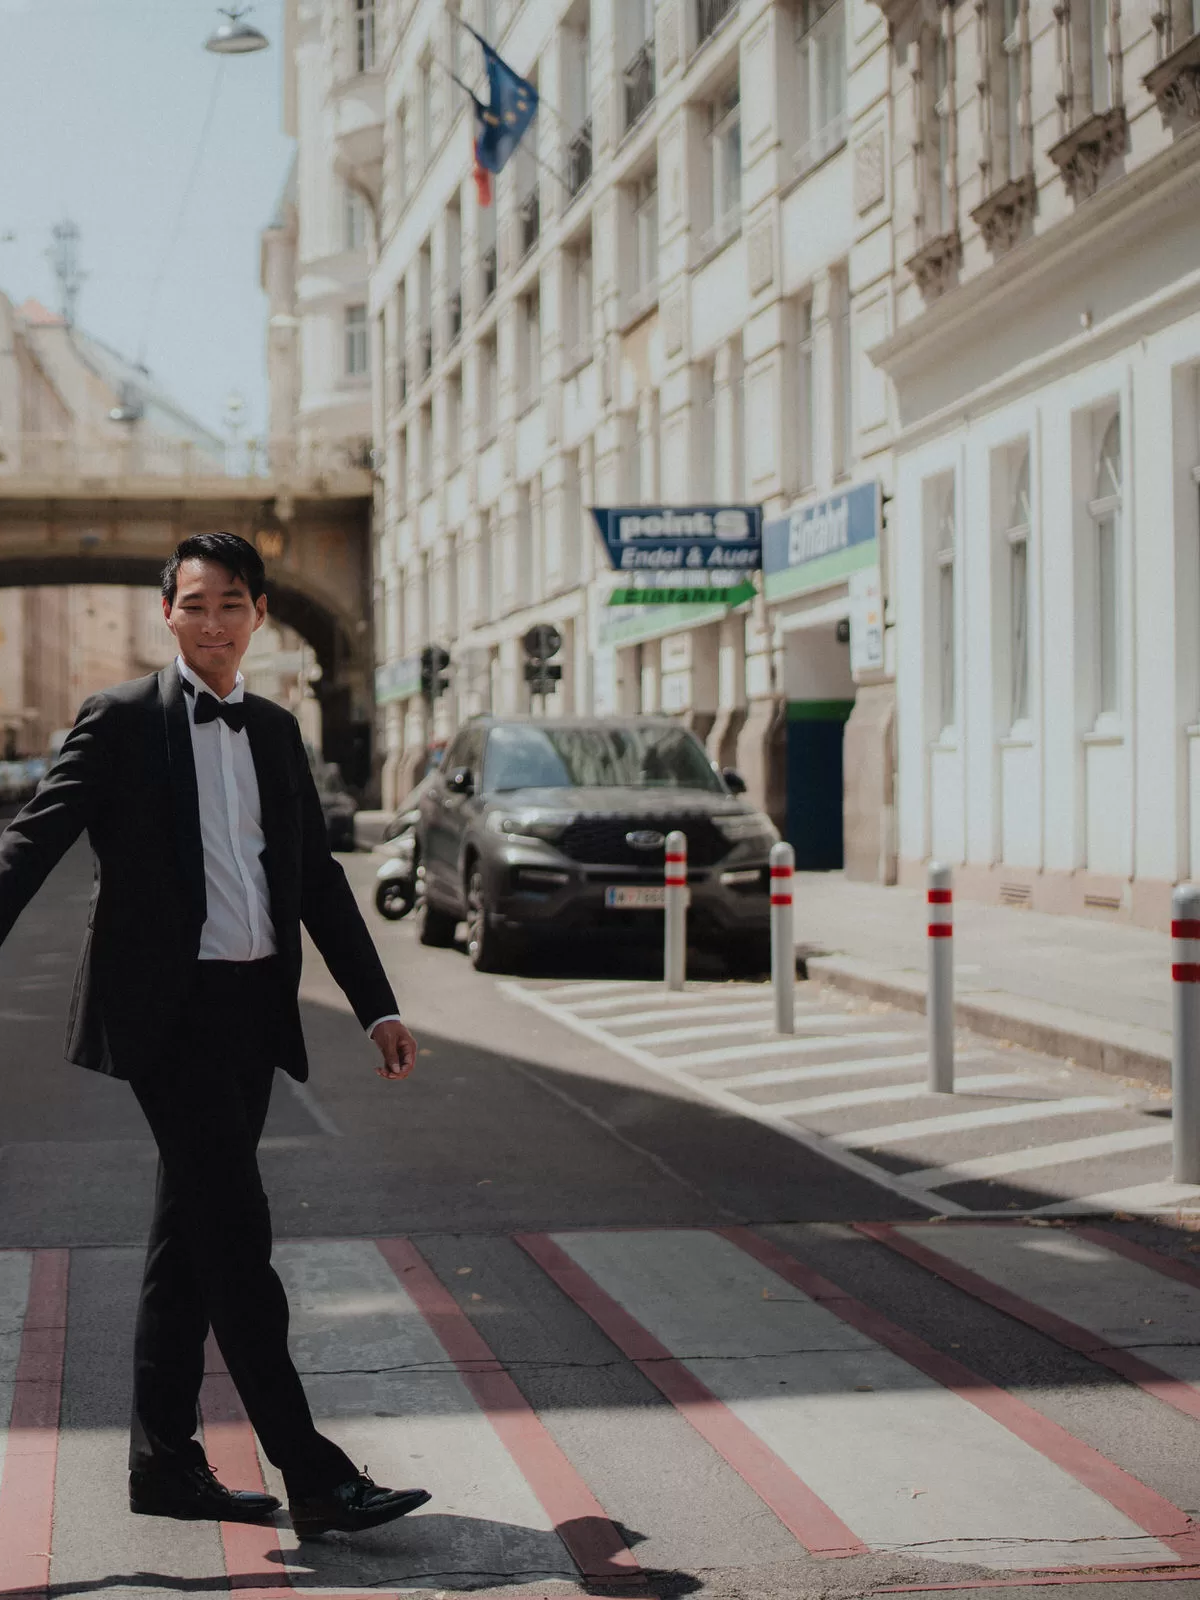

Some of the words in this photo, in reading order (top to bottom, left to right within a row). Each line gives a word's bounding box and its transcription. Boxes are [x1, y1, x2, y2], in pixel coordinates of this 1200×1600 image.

[619, 510, 712, 543] point
[713, 510, 749, 542] S
[788, 495, 848, 567] Einfahrt
[620, 546, 684, 568] Endel
[685, 546, 703, 568] &
[706, 547, 760, 568] Auer
[623, 586, 730, 604] Einfahrt
